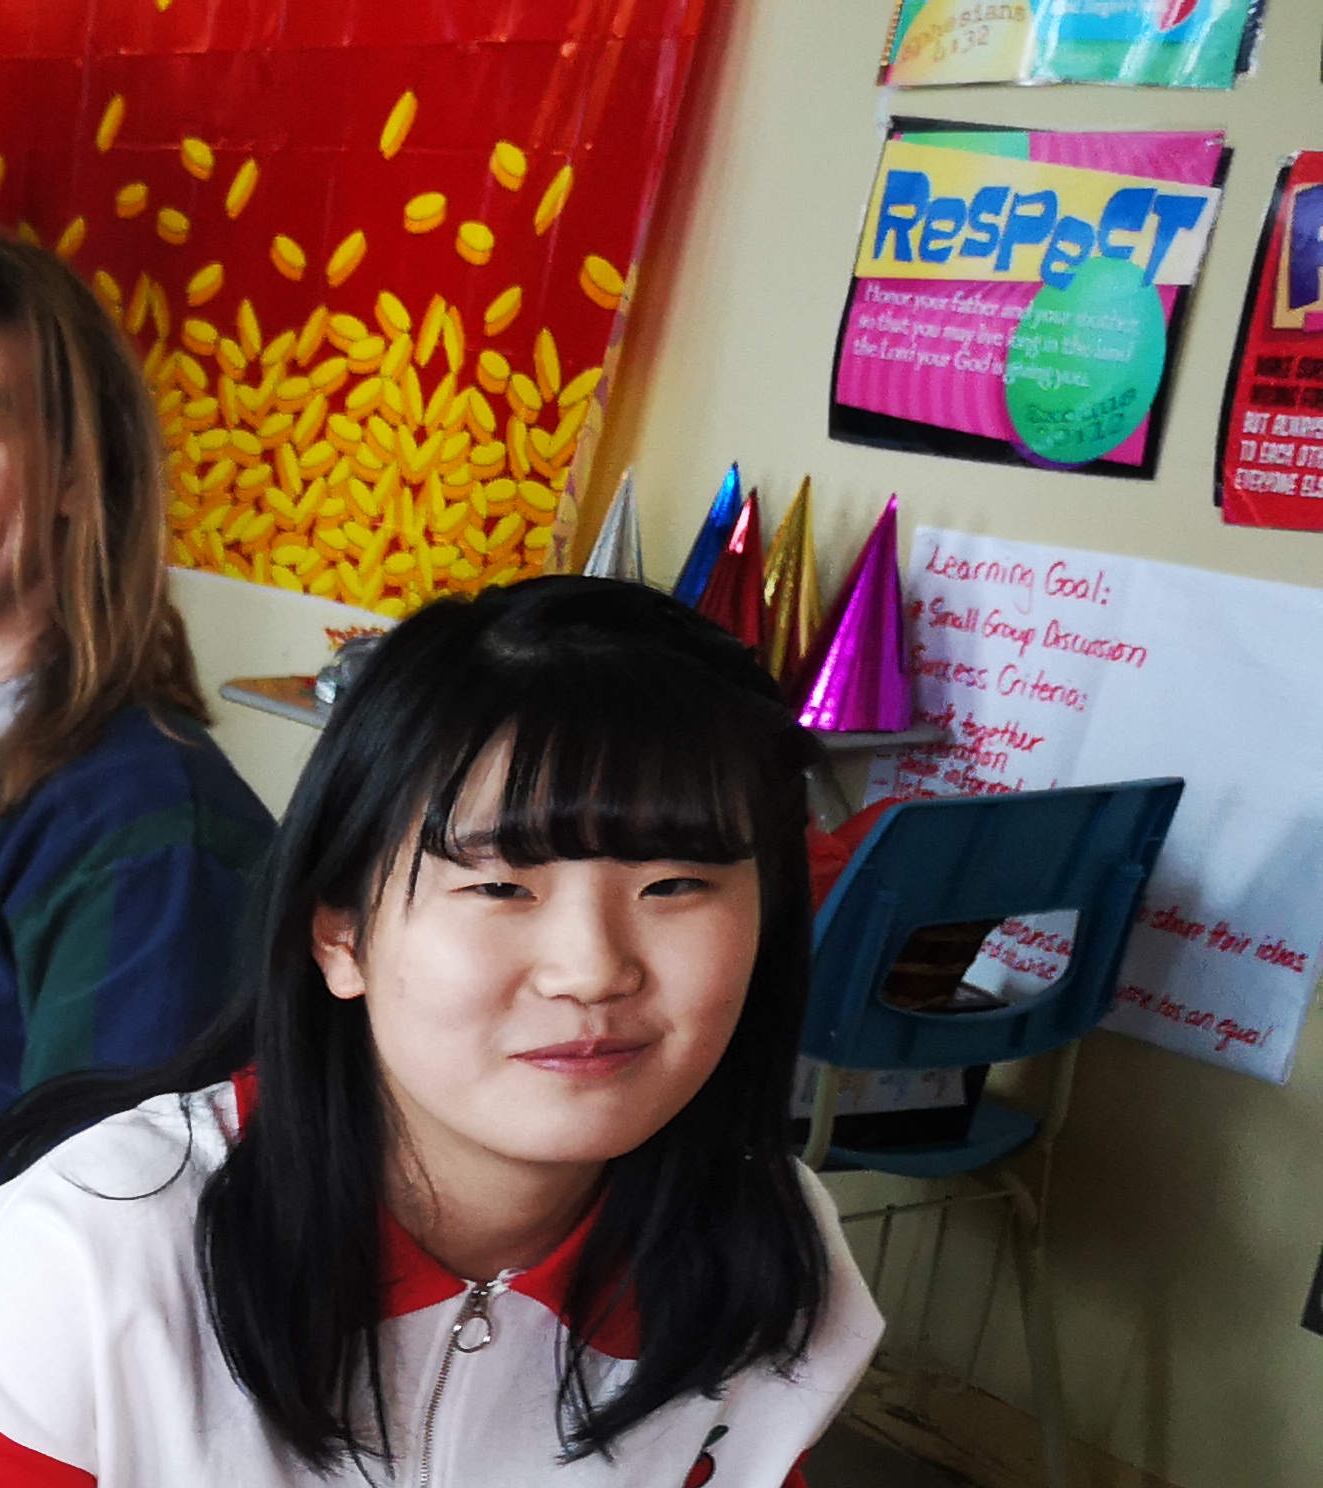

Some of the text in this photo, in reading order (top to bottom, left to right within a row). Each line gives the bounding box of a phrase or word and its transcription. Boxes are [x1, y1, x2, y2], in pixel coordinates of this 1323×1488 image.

[954, 349, 993, 375] God
[926, 547, 1111, 615] Learning Goal:
[928, 596, 1148, 668] Small Group Discussion
[997, 663, 1089, 713] Criteria:
